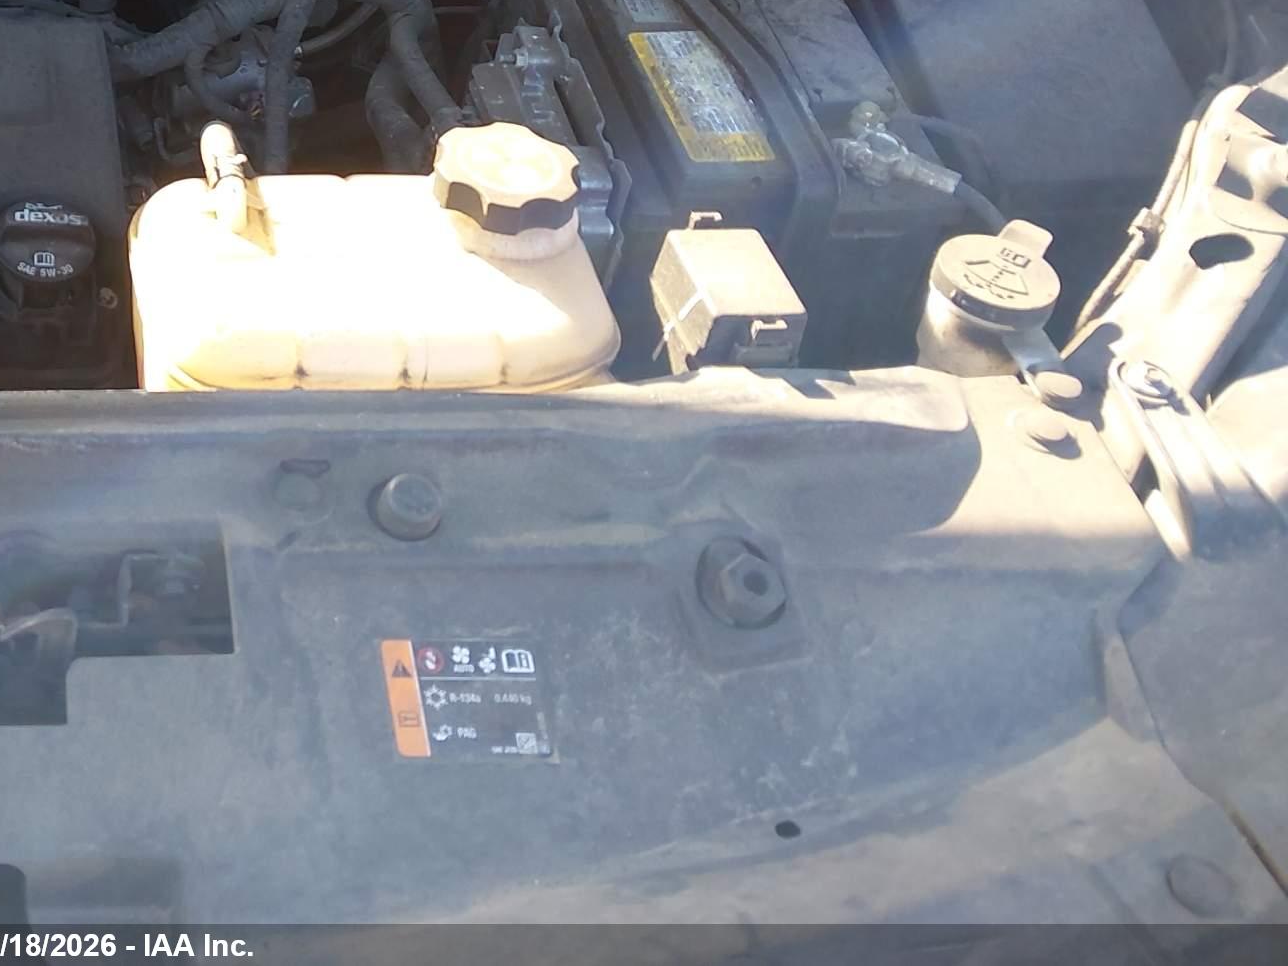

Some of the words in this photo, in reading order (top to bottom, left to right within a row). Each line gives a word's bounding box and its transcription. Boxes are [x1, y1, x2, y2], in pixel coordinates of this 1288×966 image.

[14, 208, 83, 226] dexos
[17, 262, 35, 276] SAE
[39, 264, 73, 278] 5W-30
